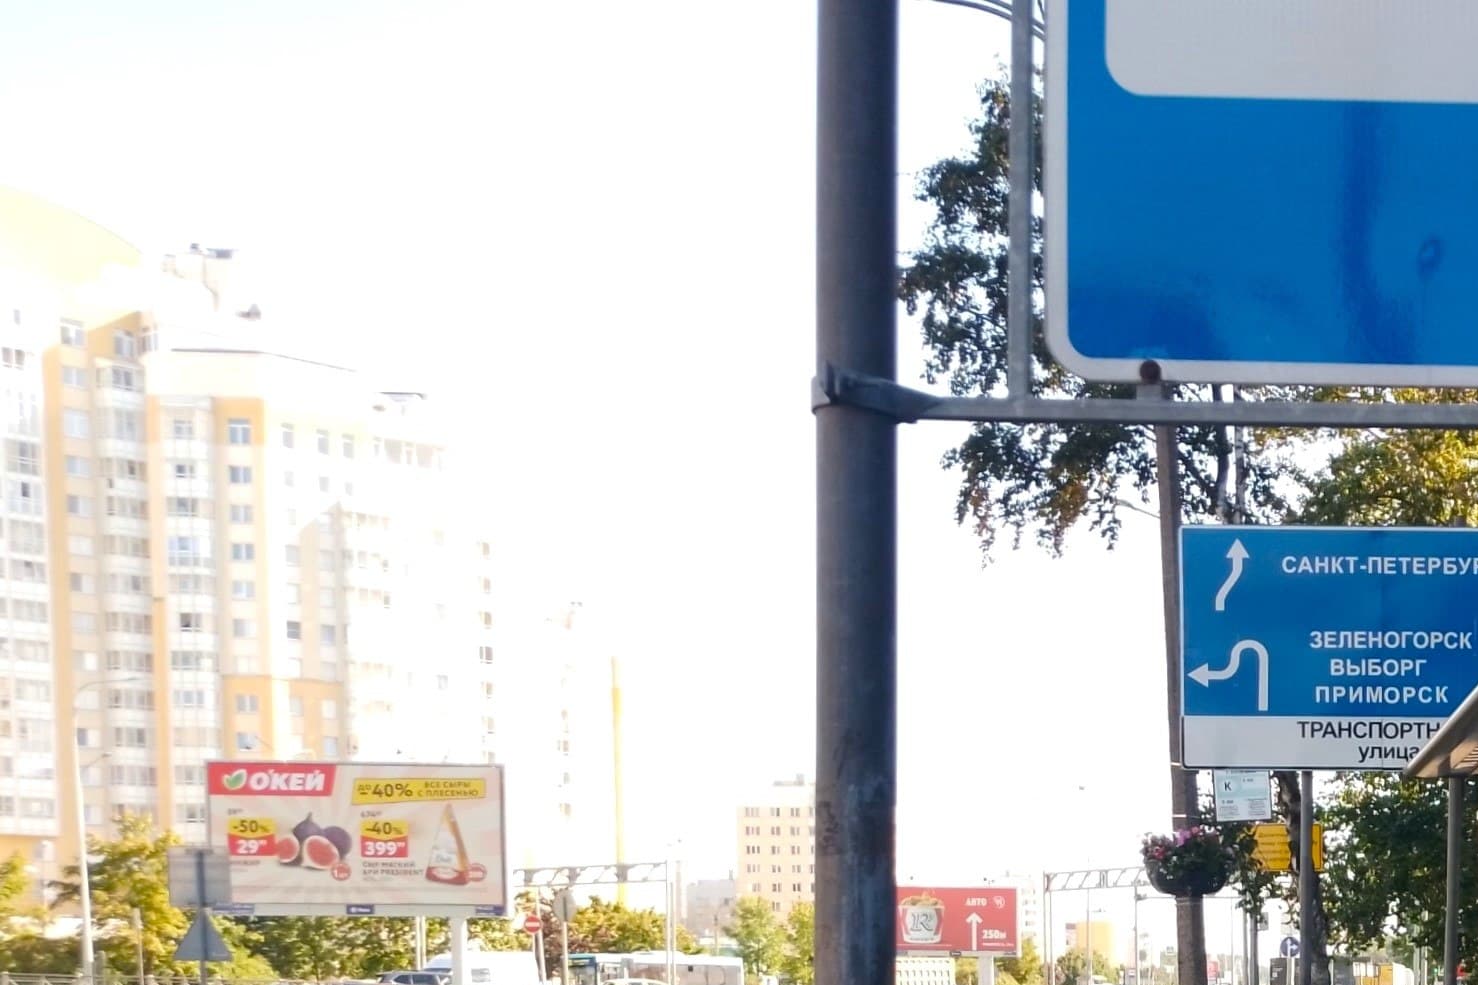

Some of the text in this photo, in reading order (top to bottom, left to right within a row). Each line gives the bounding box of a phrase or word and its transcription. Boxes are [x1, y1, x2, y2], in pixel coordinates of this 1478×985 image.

[1309, 631, 1472, 650] ЗЕЛЕНОГОРСК
[1330, 659, 1427, 677] ВЫБОРГ
[1315, 686, 1449, 704] ПРИМОРСК
[1296, 720, 1440, 739] ТРАНСПОРТН
